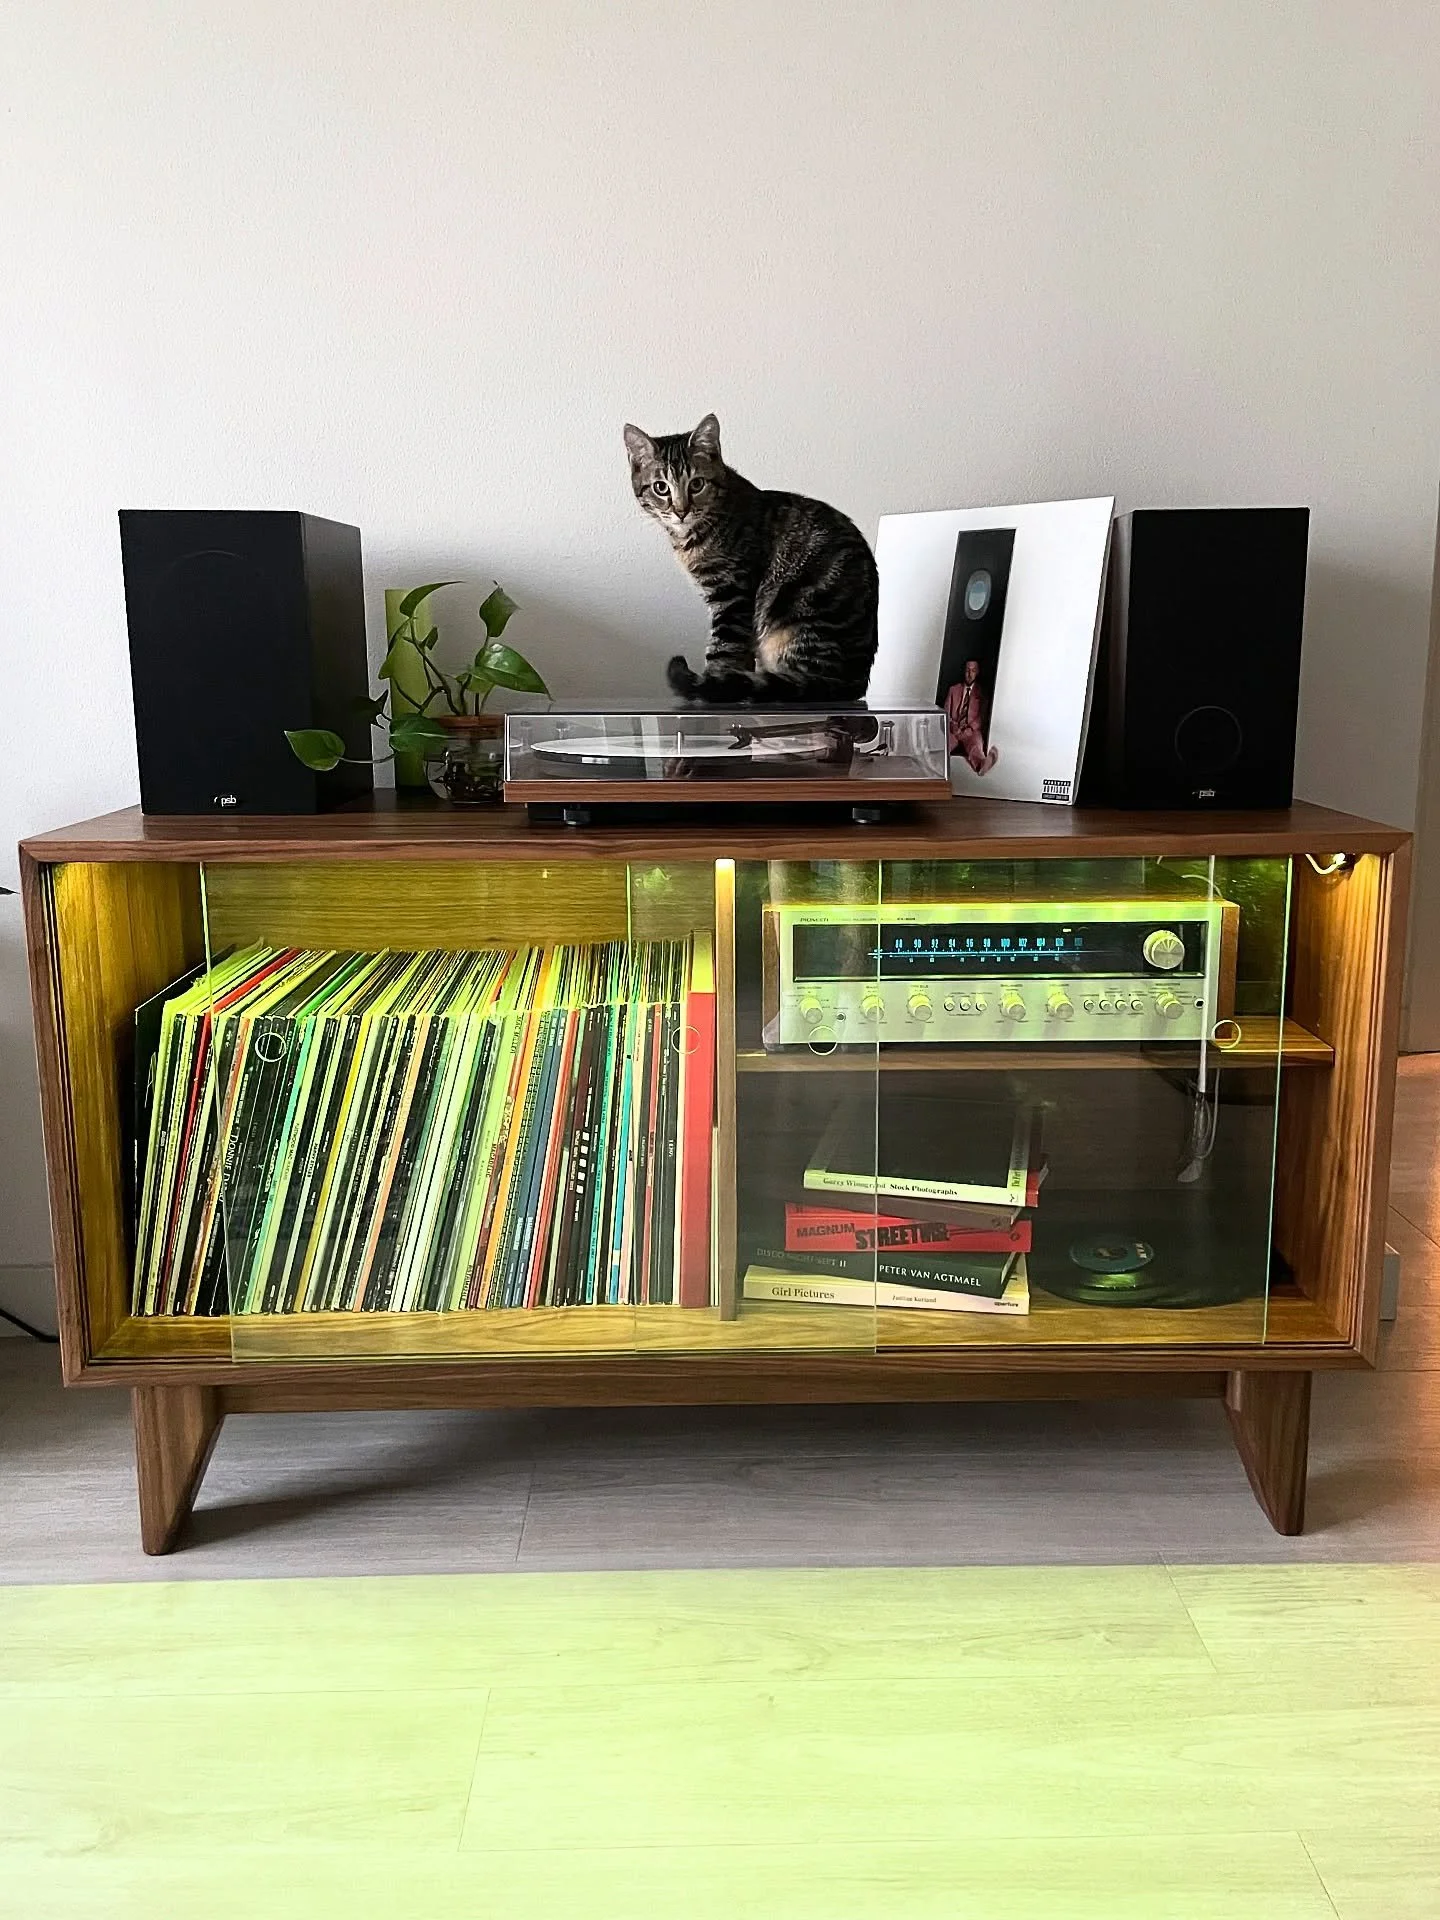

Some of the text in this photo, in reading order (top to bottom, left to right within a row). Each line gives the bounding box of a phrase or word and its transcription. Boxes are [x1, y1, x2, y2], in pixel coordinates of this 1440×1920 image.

[220, 794, 237, 807] psb
[225, 1134, 238, 1170] DONNIE
[889, 1183, 911, 1192] Stock
[911, 1184, 958, 1197] Photographs
[796, 1222, 856, 1239] MAGNUM
[756, 1248, 785, 1259] DISCO
[879, 1264, 982, 1287] PETER VAN AGTMAEL
[771, 1286, 835, 1300] Girl Pictures
